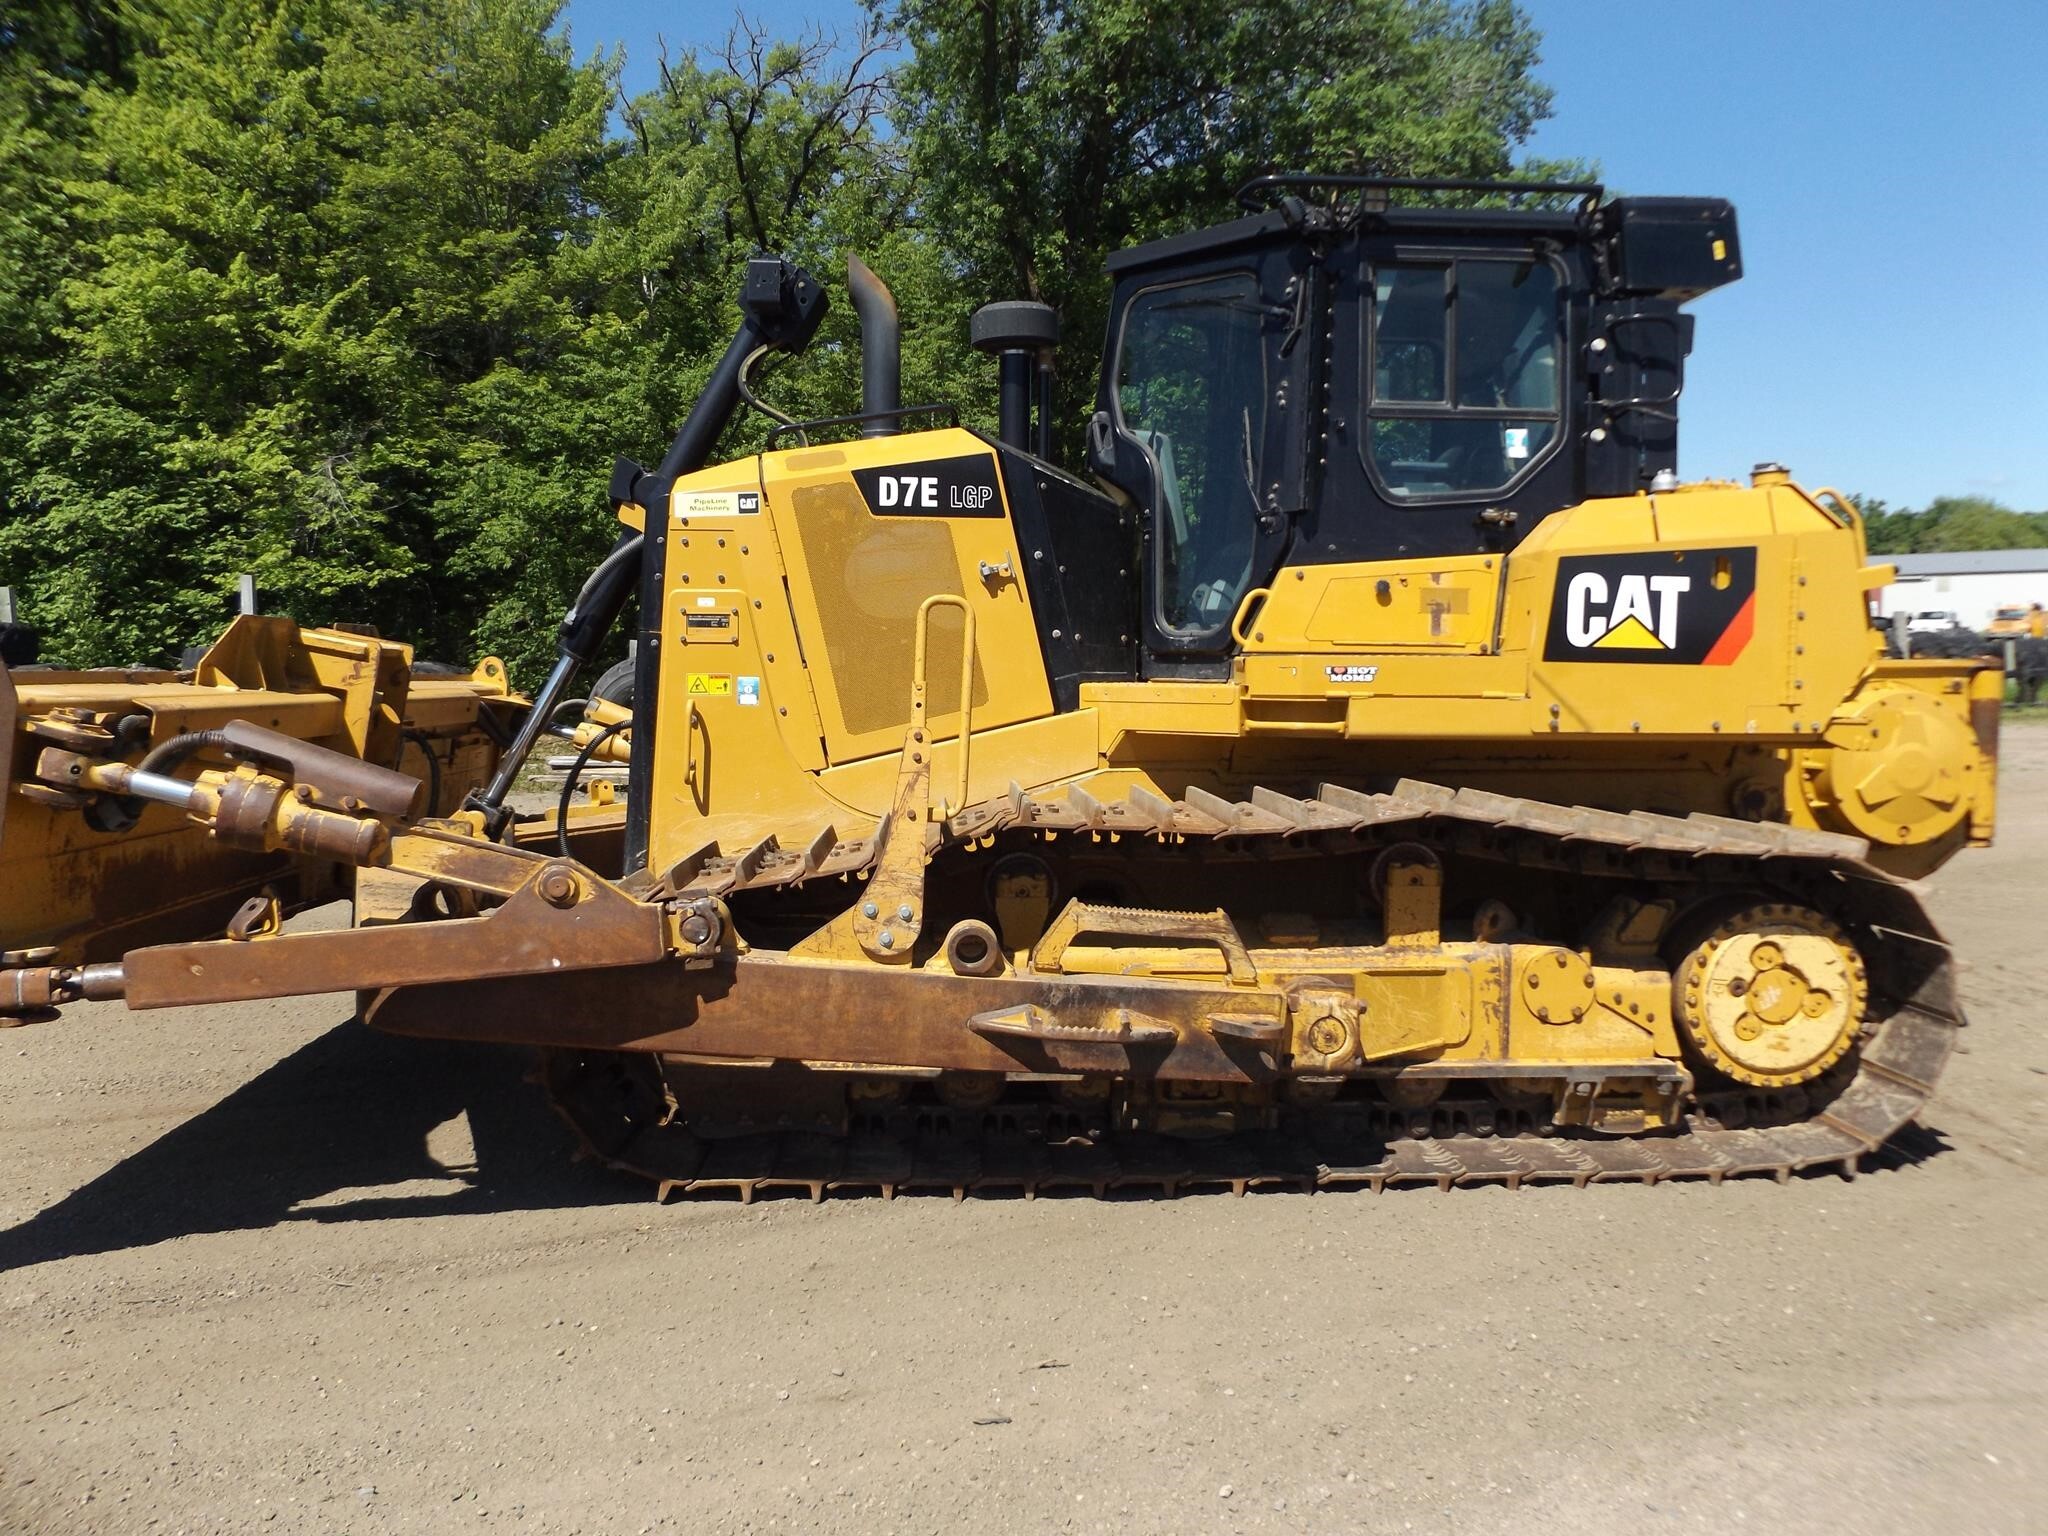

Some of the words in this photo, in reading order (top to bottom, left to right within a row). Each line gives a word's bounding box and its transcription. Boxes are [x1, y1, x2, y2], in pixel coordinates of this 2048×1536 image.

[879, 476, 938, 507] D7E
[950, 485, 993, 508] LGP
[740, 497, 758, 509] CAT
[1566, 571, 1691, 649] CAT
[1347, 666, 1378, 675] HOT
[1330, 674, 1374, 682] MOMS
